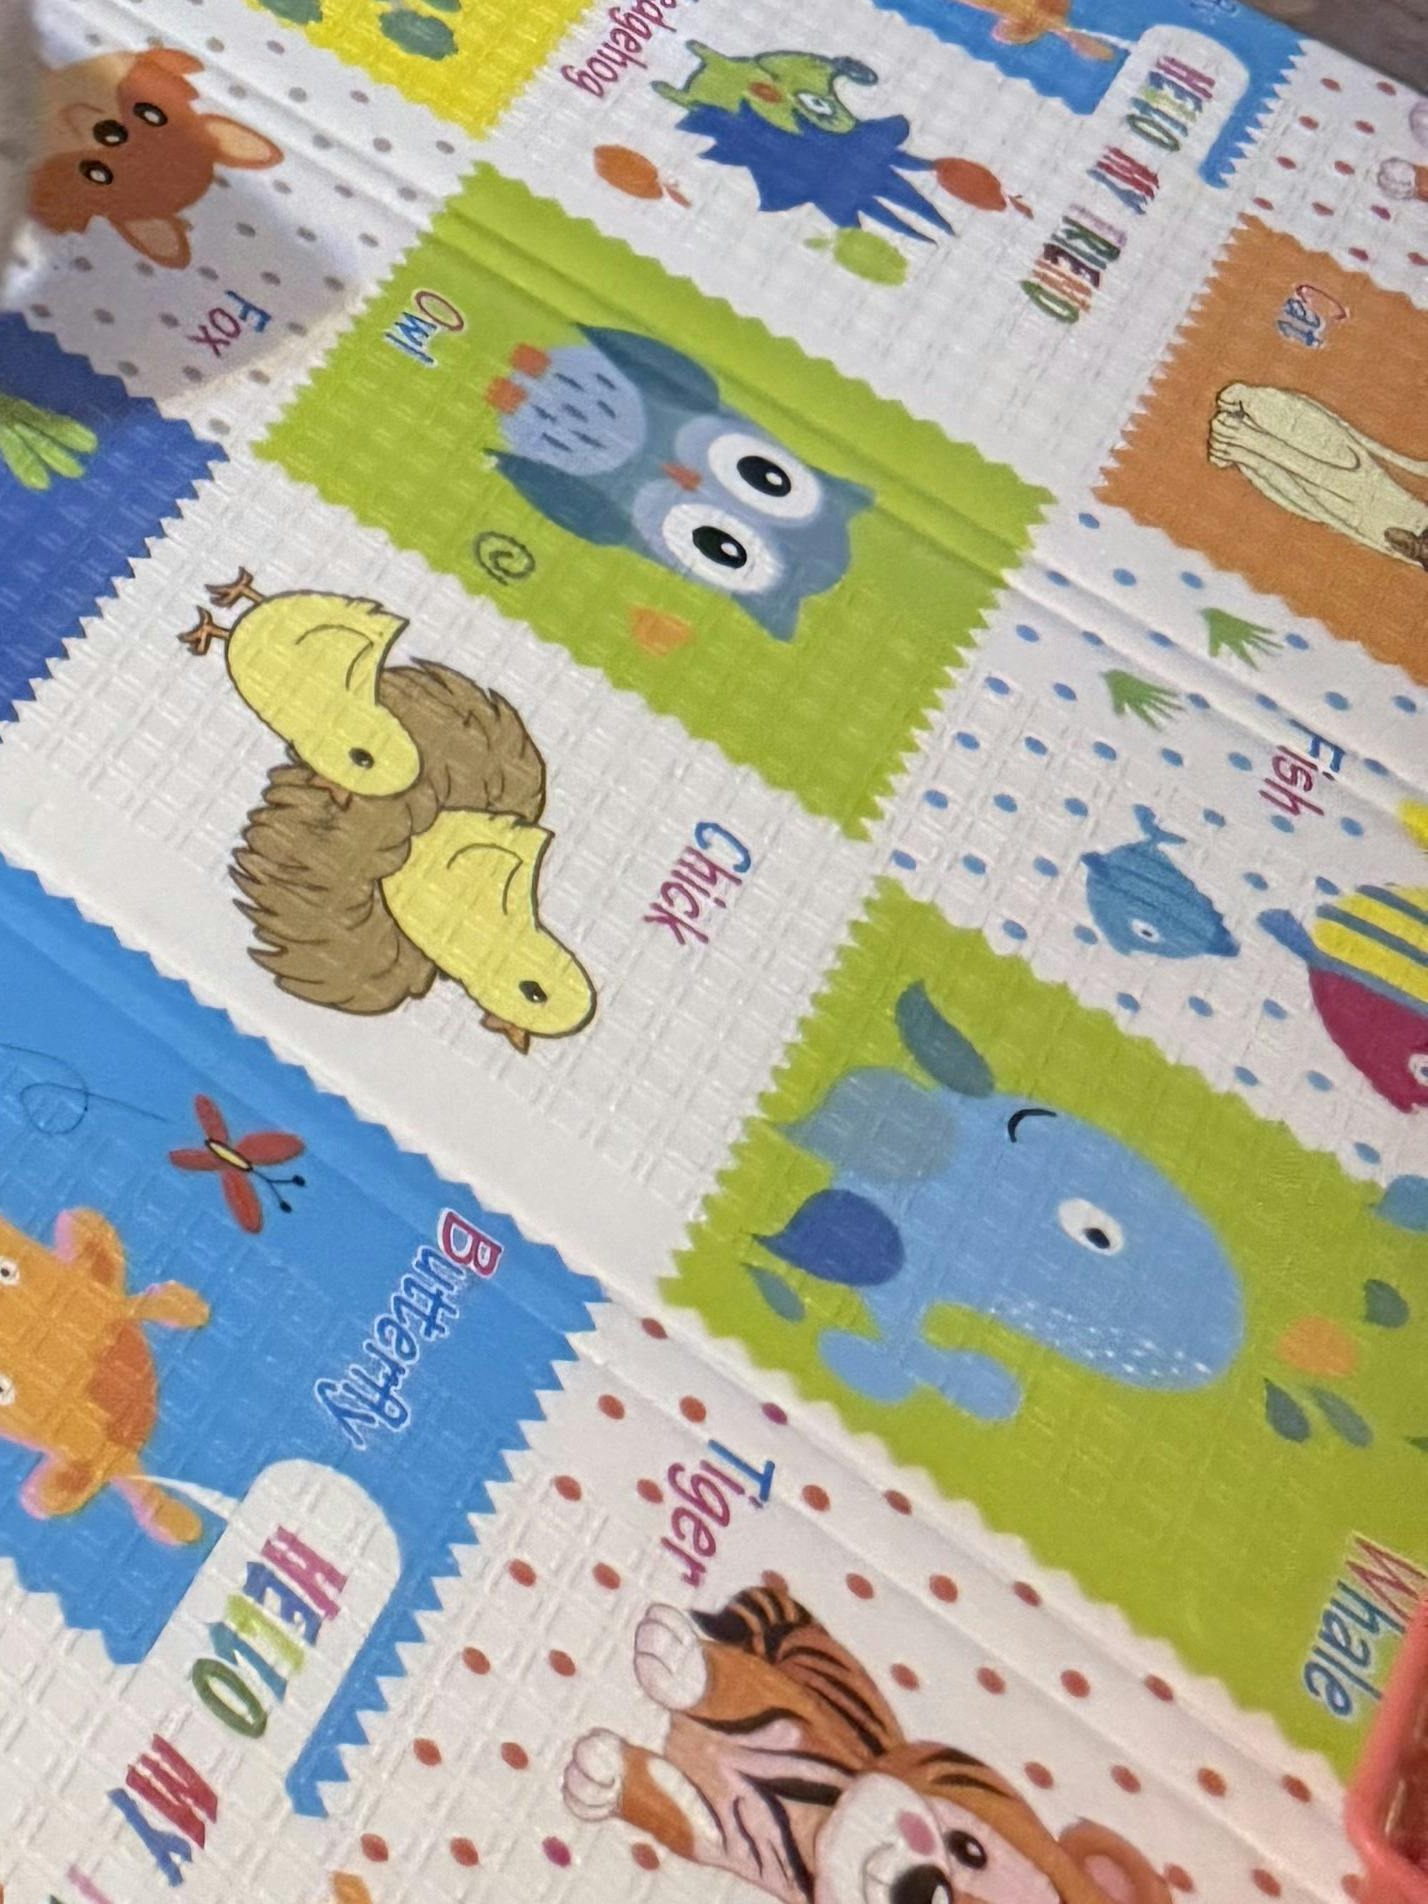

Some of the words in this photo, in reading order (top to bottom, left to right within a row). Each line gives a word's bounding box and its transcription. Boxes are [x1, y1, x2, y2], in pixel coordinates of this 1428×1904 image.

[1125, 55, 1216, 152] HELLO
[1086, 145, 1160, 215] MY
[186, 286, 272, 358] Fox
[1020, 204, 1128, 324] FRIEND
[1276, 283, 1350, 349] Cat
[383, 289, 464, 369] Owl
[1259, 718, 1345, 817] Fish
[643, 822, 751, 945] Chick
[312, 1205, 503, 1449] Butterfly
[659, 1440, 781, 1587] Tiger
[191, 1525, 349, 1738] HELLO
[1304, 1532, 1428, 1718] Whale
[107, 1733, 218, 1887] MY
